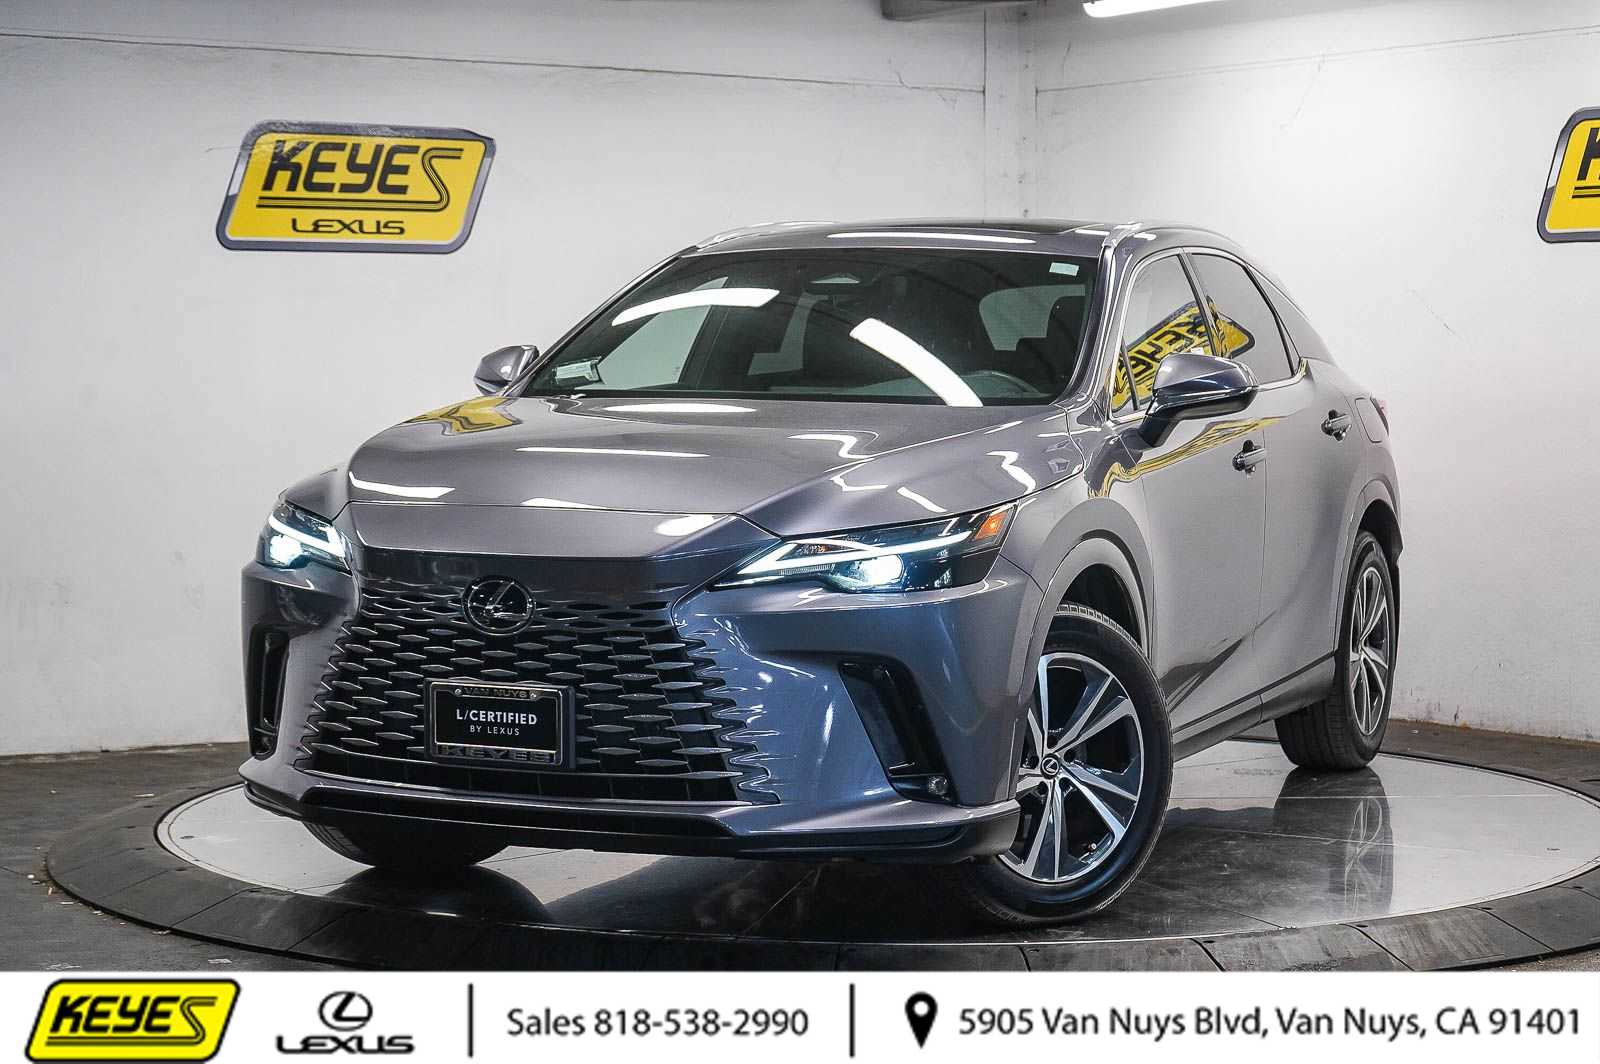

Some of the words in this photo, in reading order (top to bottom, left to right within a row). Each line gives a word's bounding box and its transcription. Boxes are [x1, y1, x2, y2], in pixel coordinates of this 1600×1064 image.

[256, 139, 464, 212] KEYES
[291, 218, 406, 235] LEXUS
[464, 686, 489, 696] VAN
[494, 688, 529, 698] NUYS
[456, 708, 538, 725] L/CERTIFIED
[470, 725, 482, 733] BY
[487, 726, 520, 736] LEXUS
